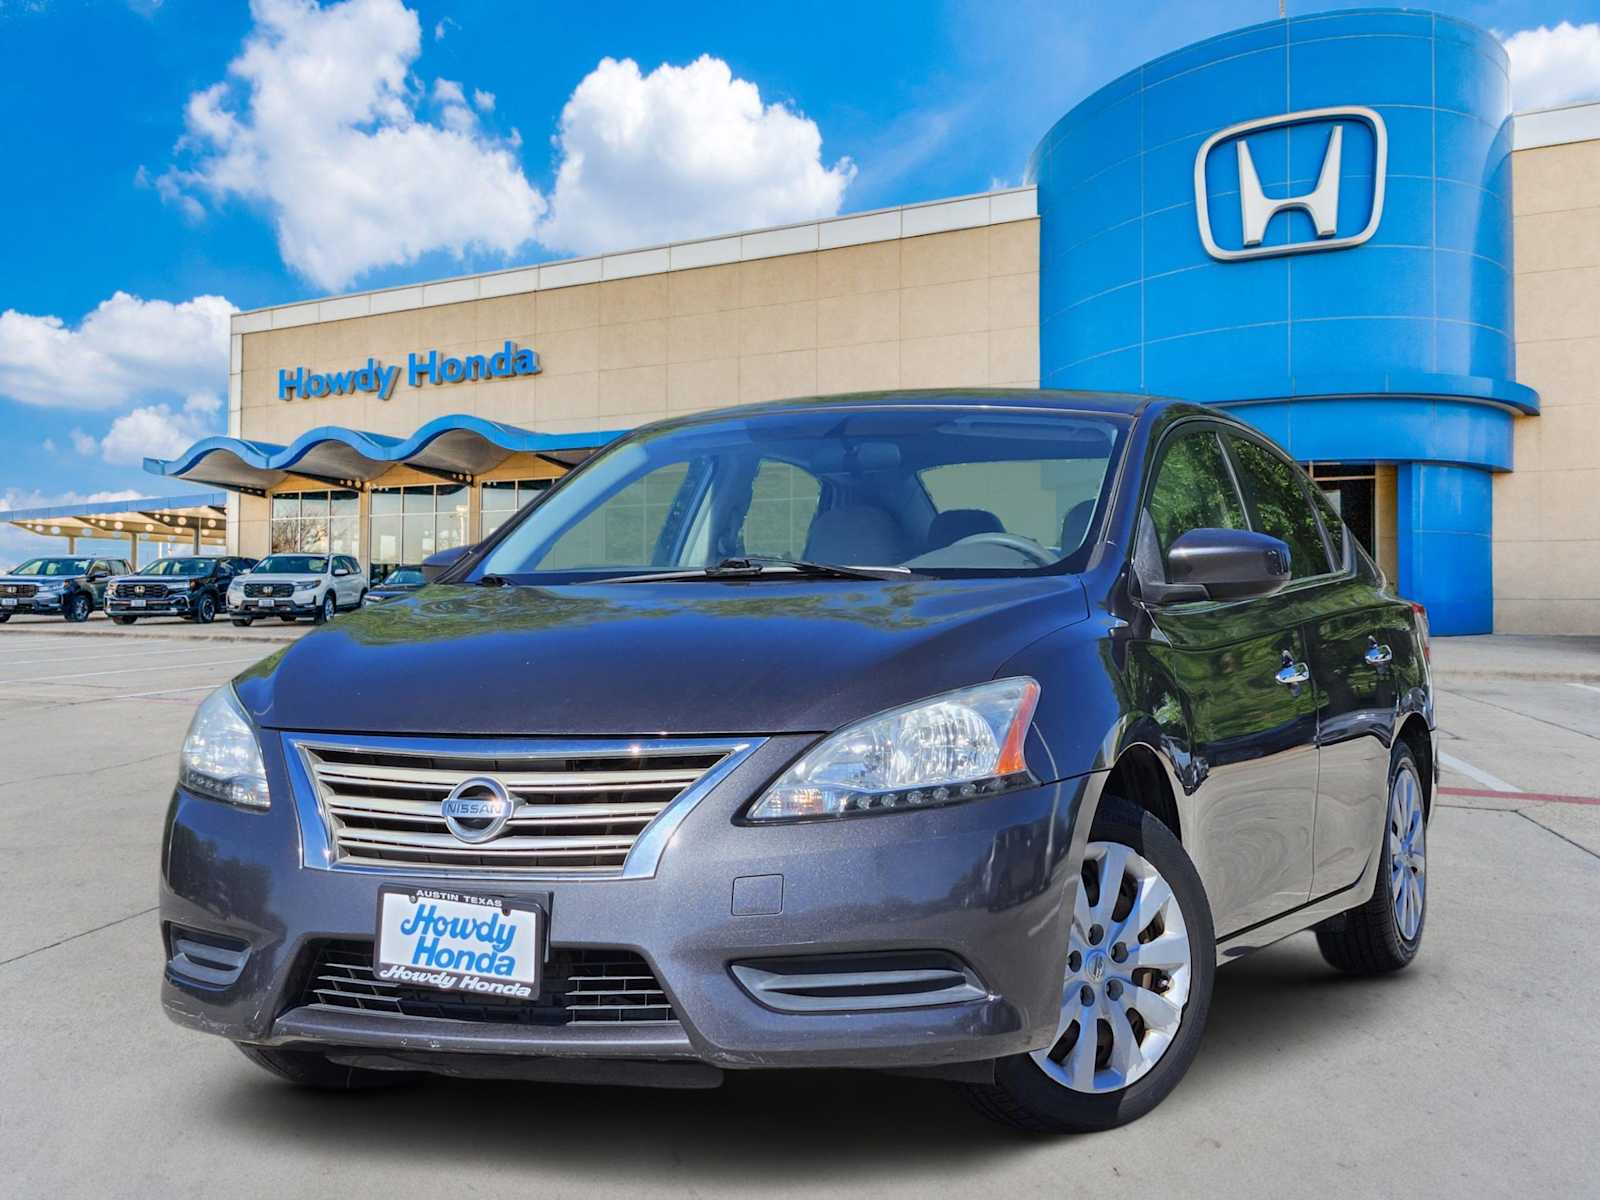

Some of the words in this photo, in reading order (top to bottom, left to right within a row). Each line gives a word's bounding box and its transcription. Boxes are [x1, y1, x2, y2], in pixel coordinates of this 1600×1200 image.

[278, 357, 401, 400] Howdy
[408, 340, 541, 387] Honda
[446, 803, 502, 814] NISSAN
[416, 889, 459, 902] AUSTIN
[464, 895, 502, 907] TEXAS
[400, 903, 516, 952] Howdy
[412, 935, 516, 977] Honda
[380, 965, 457, 989] Howdy
[459, 975, 532, 998] Honda
